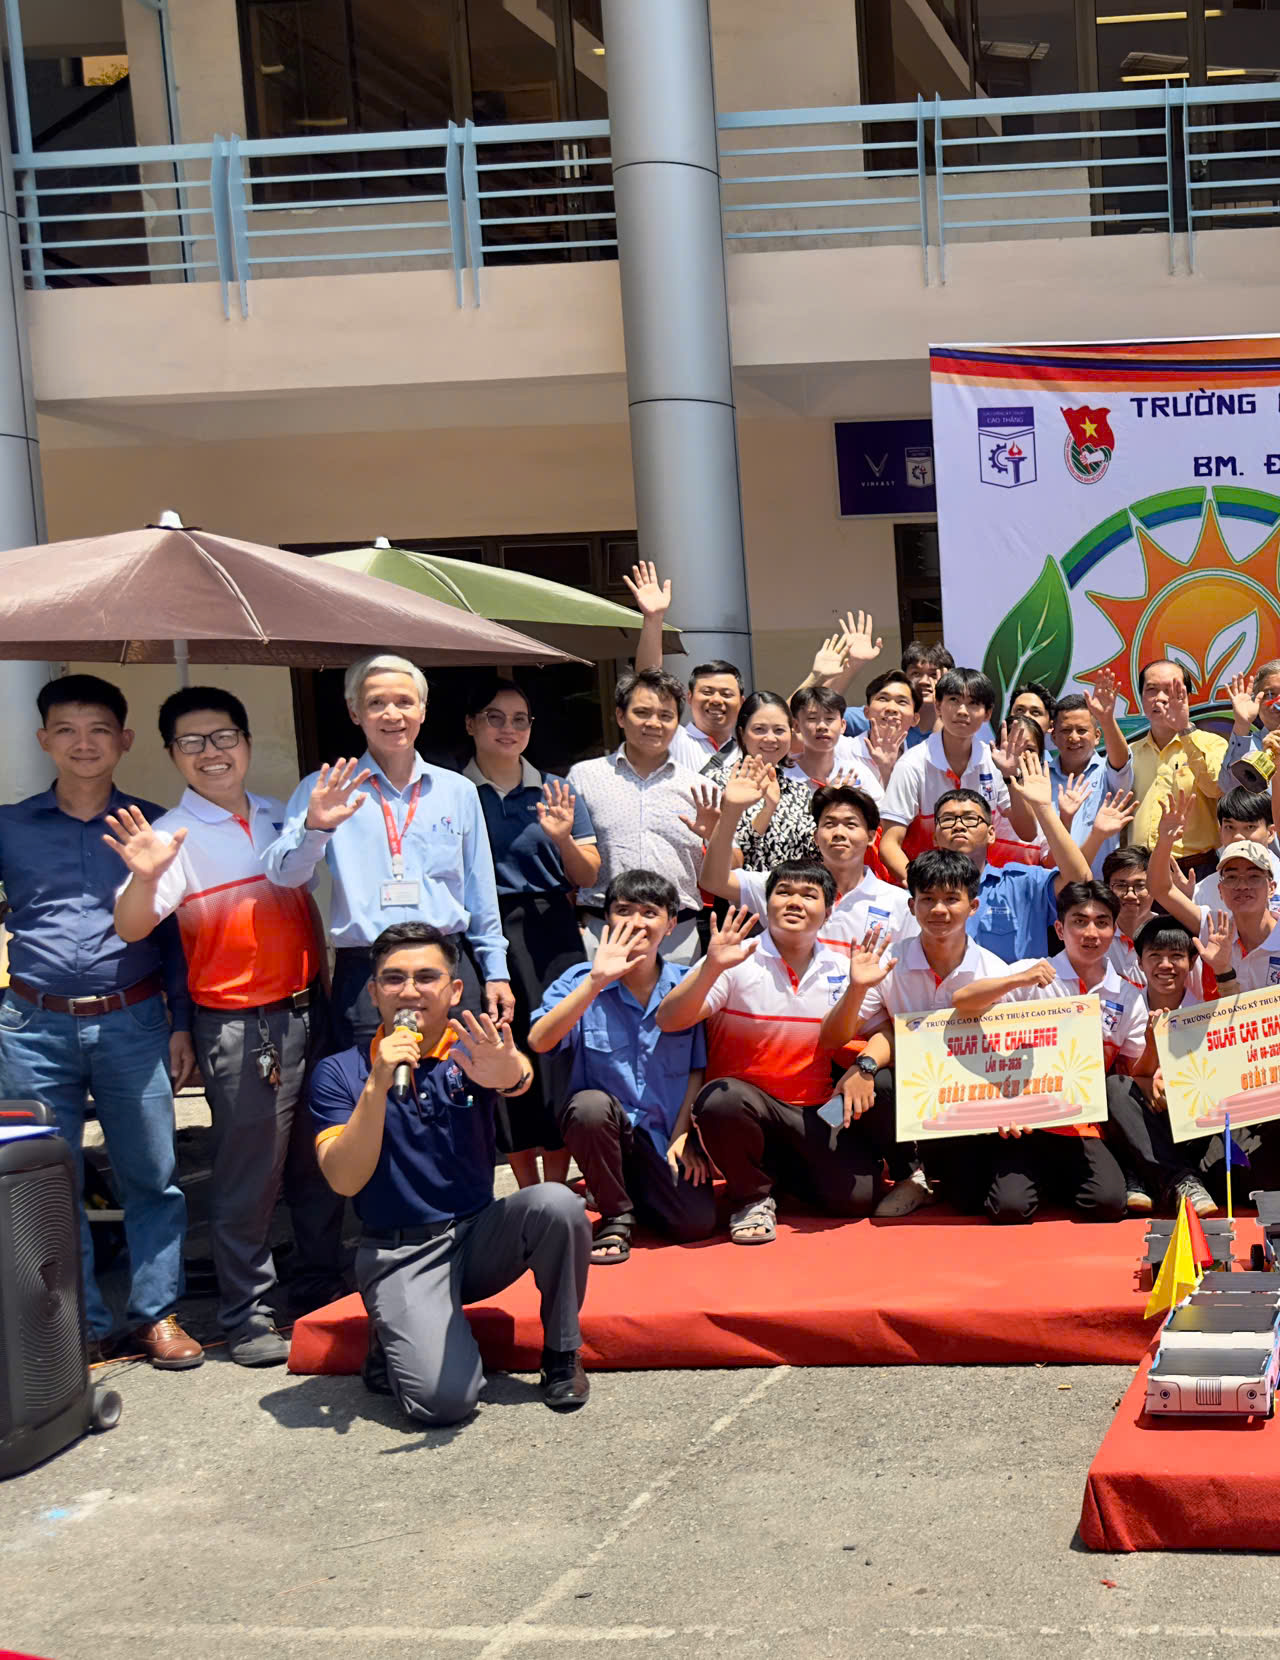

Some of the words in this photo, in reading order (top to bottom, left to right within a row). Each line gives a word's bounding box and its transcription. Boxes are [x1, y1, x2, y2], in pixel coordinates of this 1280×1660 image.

[1130, 388, 1257, 418] TRƯỜNG
[1193, 455, 1244, 477] BM.
[1031, 1010, 1046, 1018] CAO
[1212, 1009, 1227, 1019] CAO
[947, 1034, 978, 1057] SOLAR
[982, 1032, 1001, 1054] CAR
[1005, 1027, 1058, 1051] CHALLENGE
[1206, 1024, 1237, 1052] SOLAR
[1240, 1020, 1259, 1043] CAR
